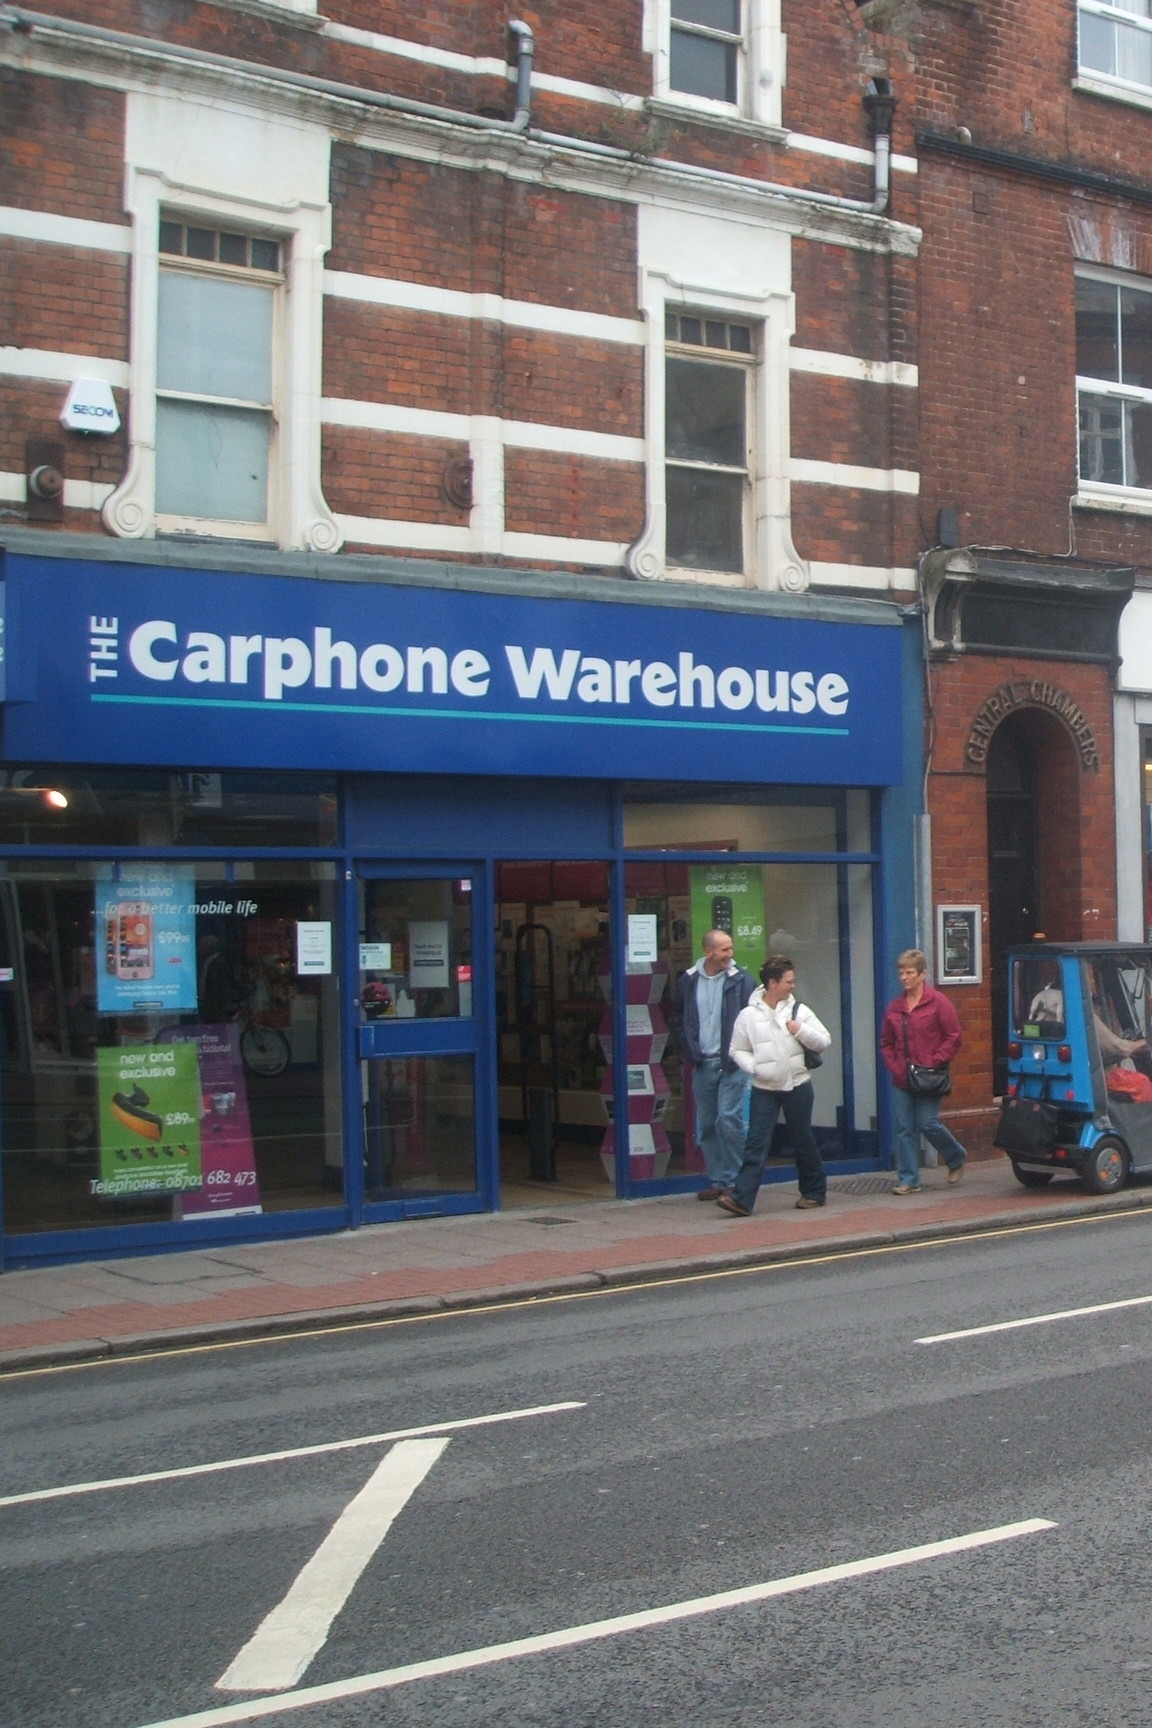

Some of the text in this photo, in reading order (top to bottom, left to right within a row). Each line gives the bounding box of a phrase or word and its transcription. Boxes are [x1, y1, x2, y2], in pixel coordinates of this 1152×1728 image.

[73, 404, 114, 418] SECOM
[90, 615, 849, 715] THE Carphone Warehouse
[968, 681, 1098, 765] CENTRAL CHAMBERS
[141, 902, 183, 914] better
[188, 901, 233, 914] mobile
[237, 900, 258, 917] life
[120, 1051, 174, 1064] new and
[120, 1066, 176, 1079] exclusive
[165, 1172, 203, 1190] 08701
[207, 1169, 231, 1185] 682
[234, 1170, 257, 1186] 473
